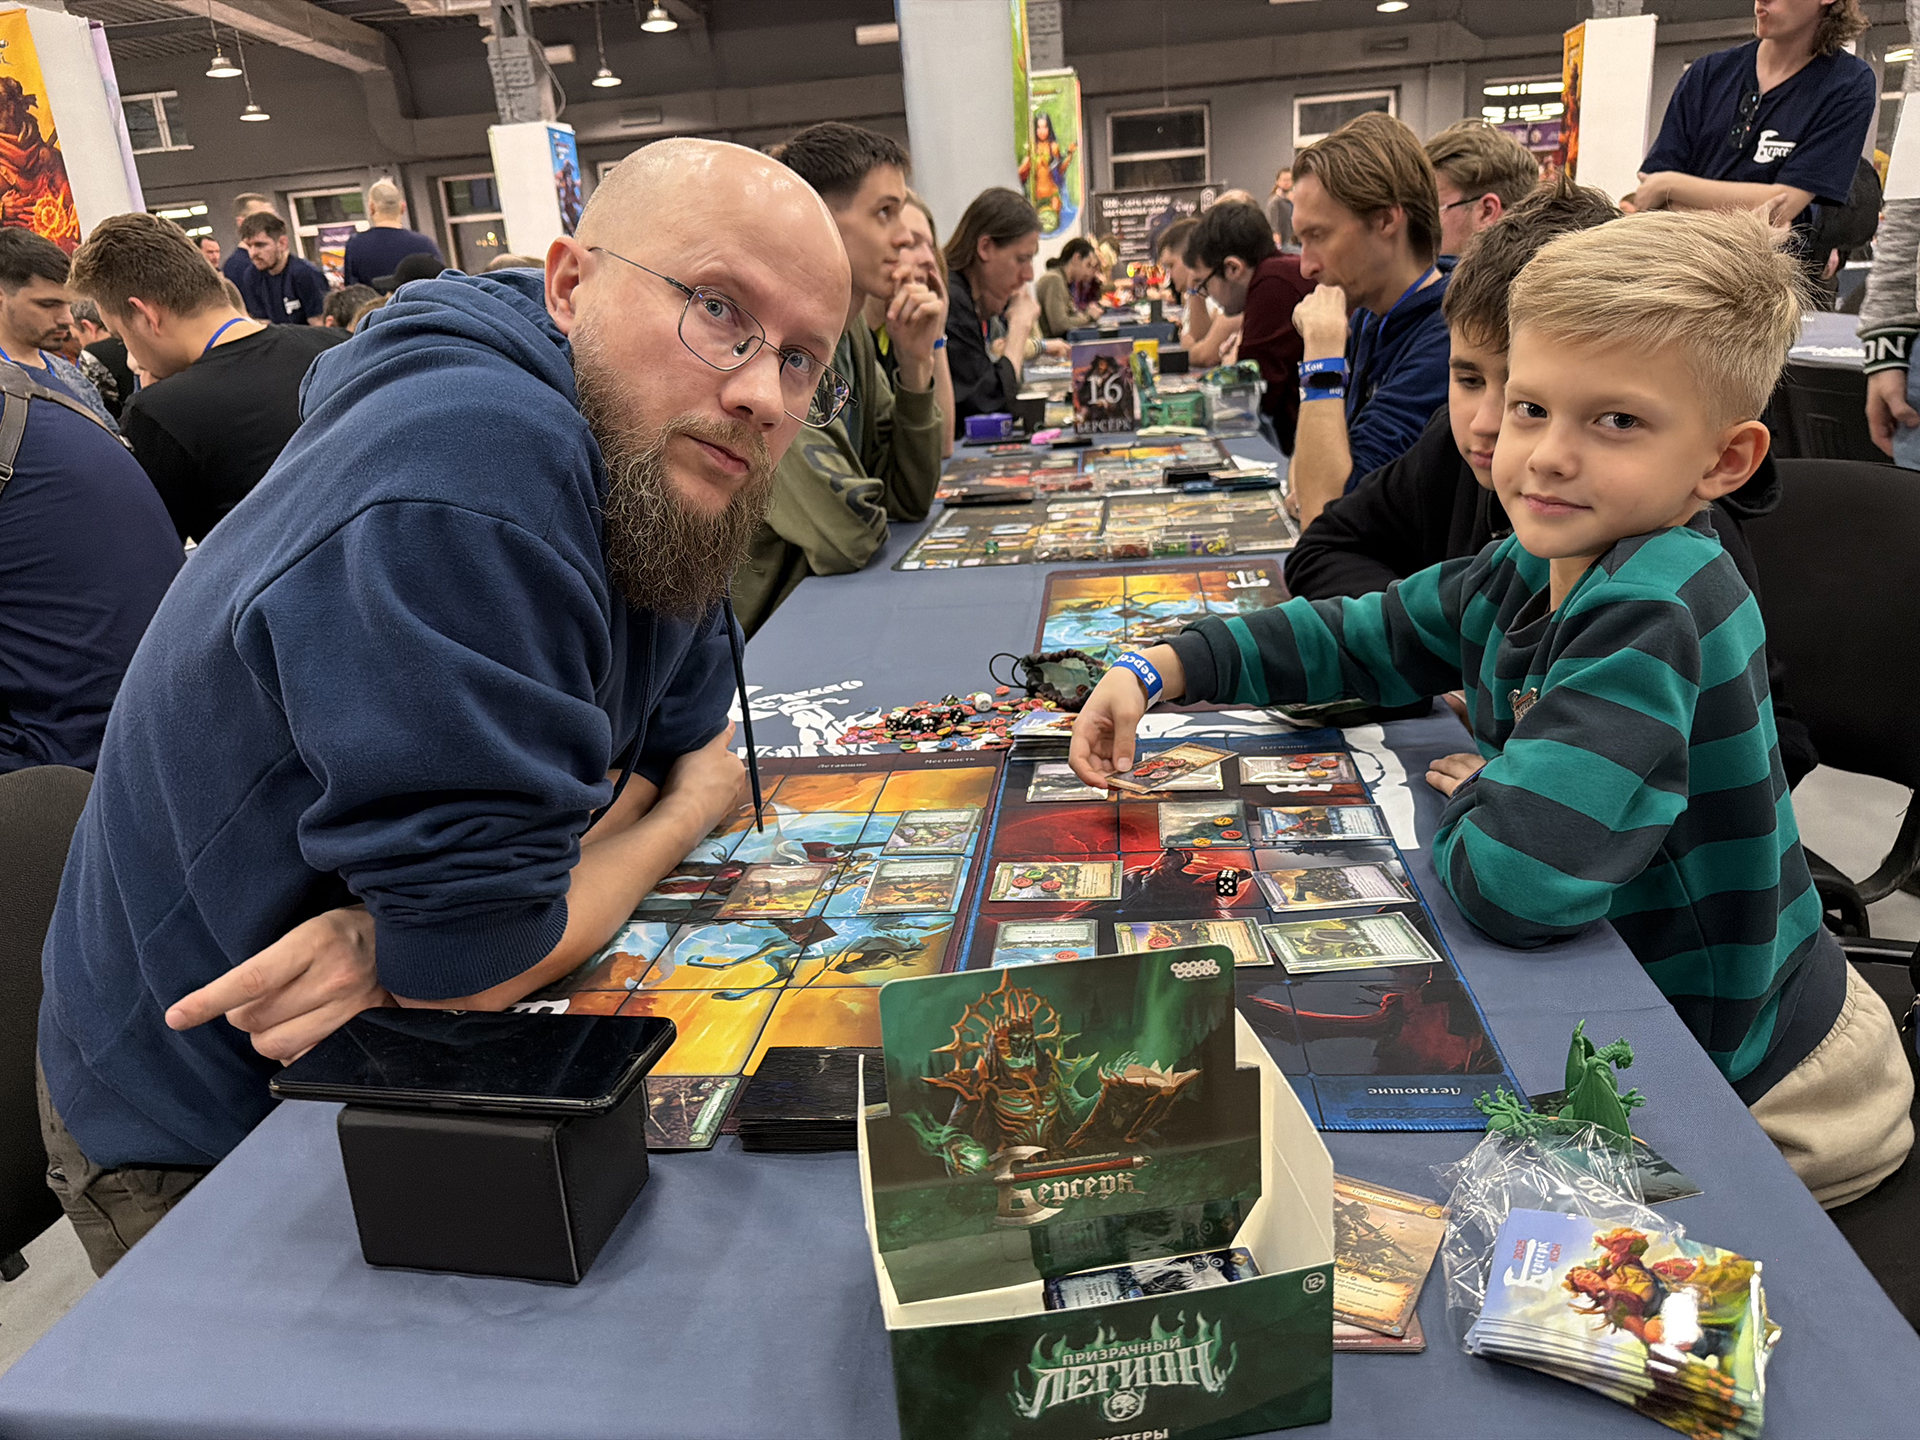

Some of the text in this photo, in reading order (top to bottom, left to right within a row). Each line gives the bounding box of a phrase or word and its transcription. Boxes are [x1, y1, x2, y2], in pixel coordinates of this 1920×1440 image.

[1087, 373, 1122, 405] 16
[1077, 417, 1132, 434] БЕРСЕРК
[1367, 1087, 1461, 1096] Летающие
[994, 1146, 1147, 1226] Берсерк
[1062, 1335, 1182, 1366] ПРИЗРАЧНЫЙ
[1020, 1340, 1224, 1418] ЛЕГИОН
[1098, 1428, 1168, 1440] ТЕРЫ
